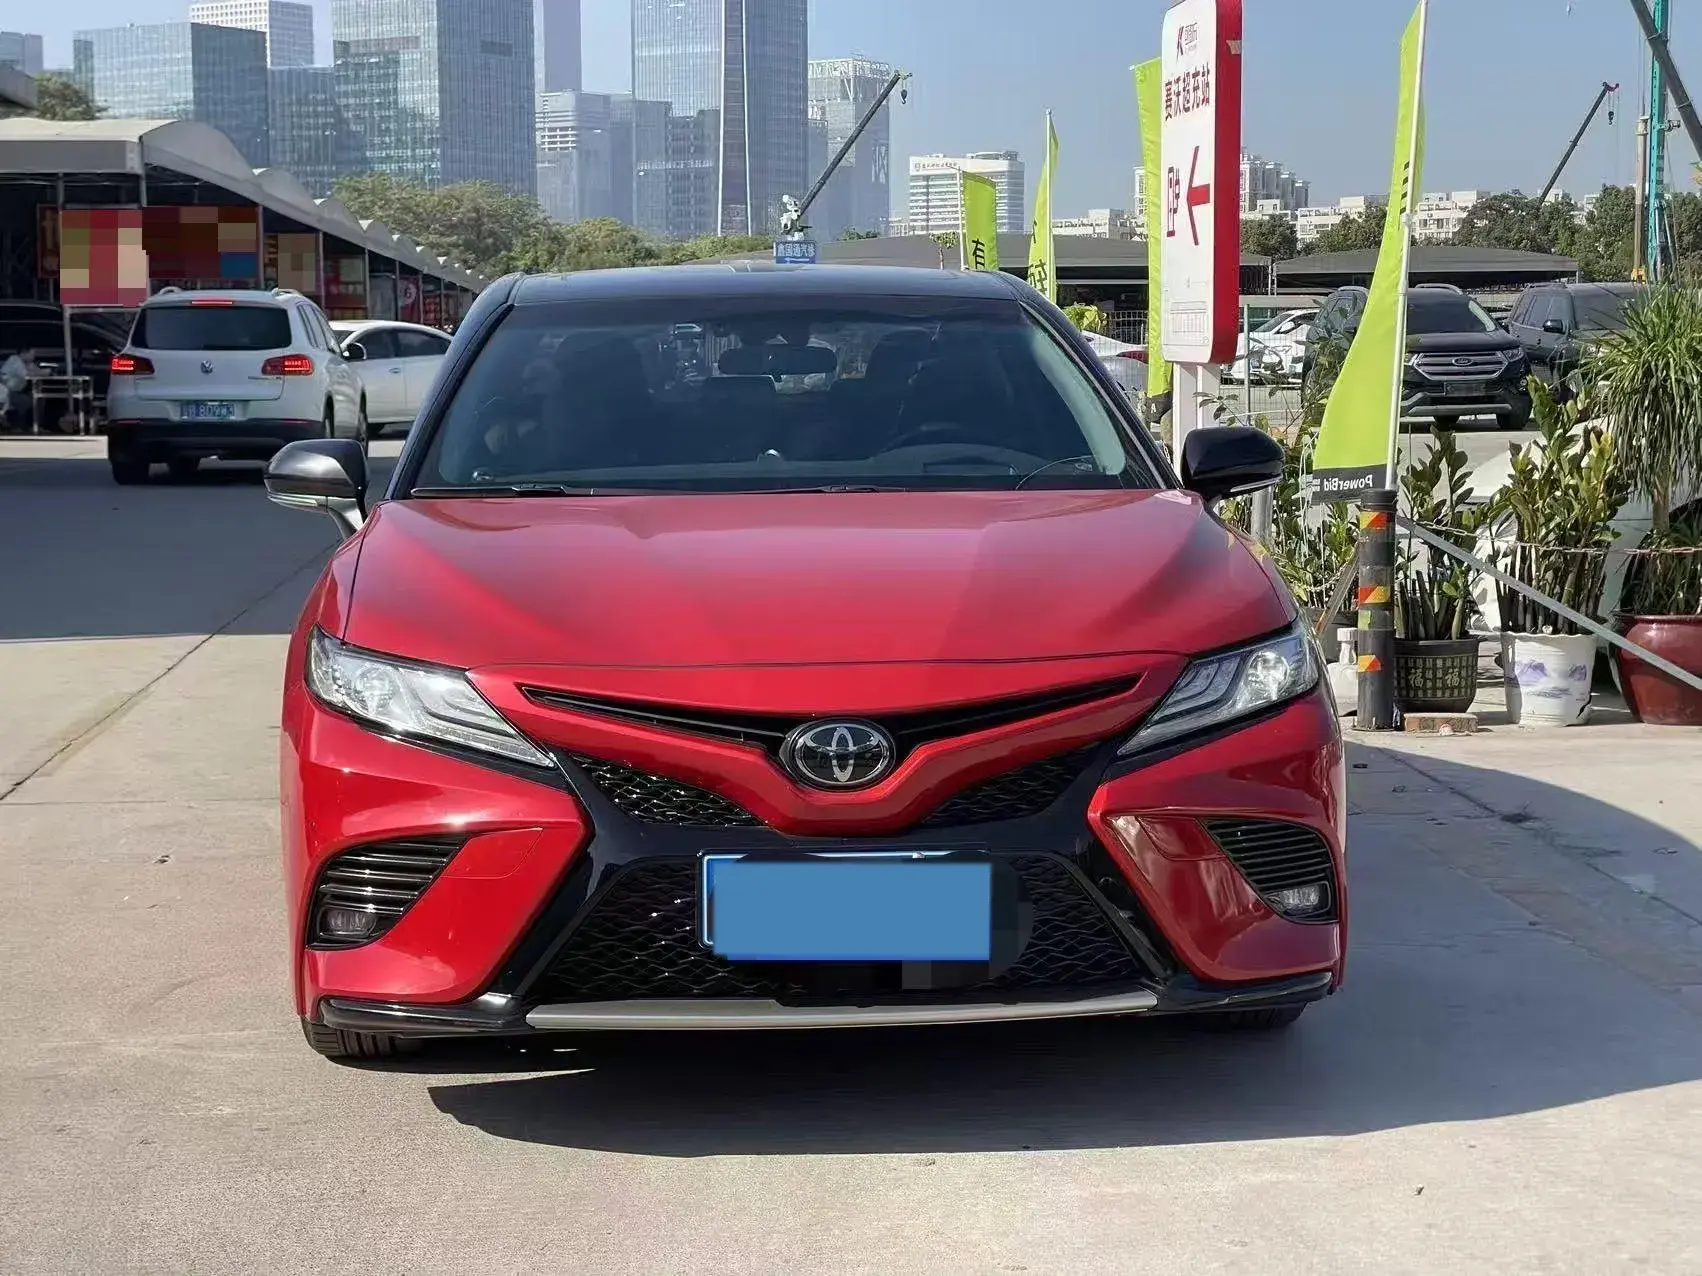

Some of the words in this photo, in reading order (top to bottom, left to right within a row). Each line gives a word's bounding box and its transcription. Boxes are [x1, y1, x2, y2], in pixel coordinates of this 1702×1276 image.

[1164, 62, 1210, 121] 赛沃超充站
[1444, 668, 1460, 687] 福
